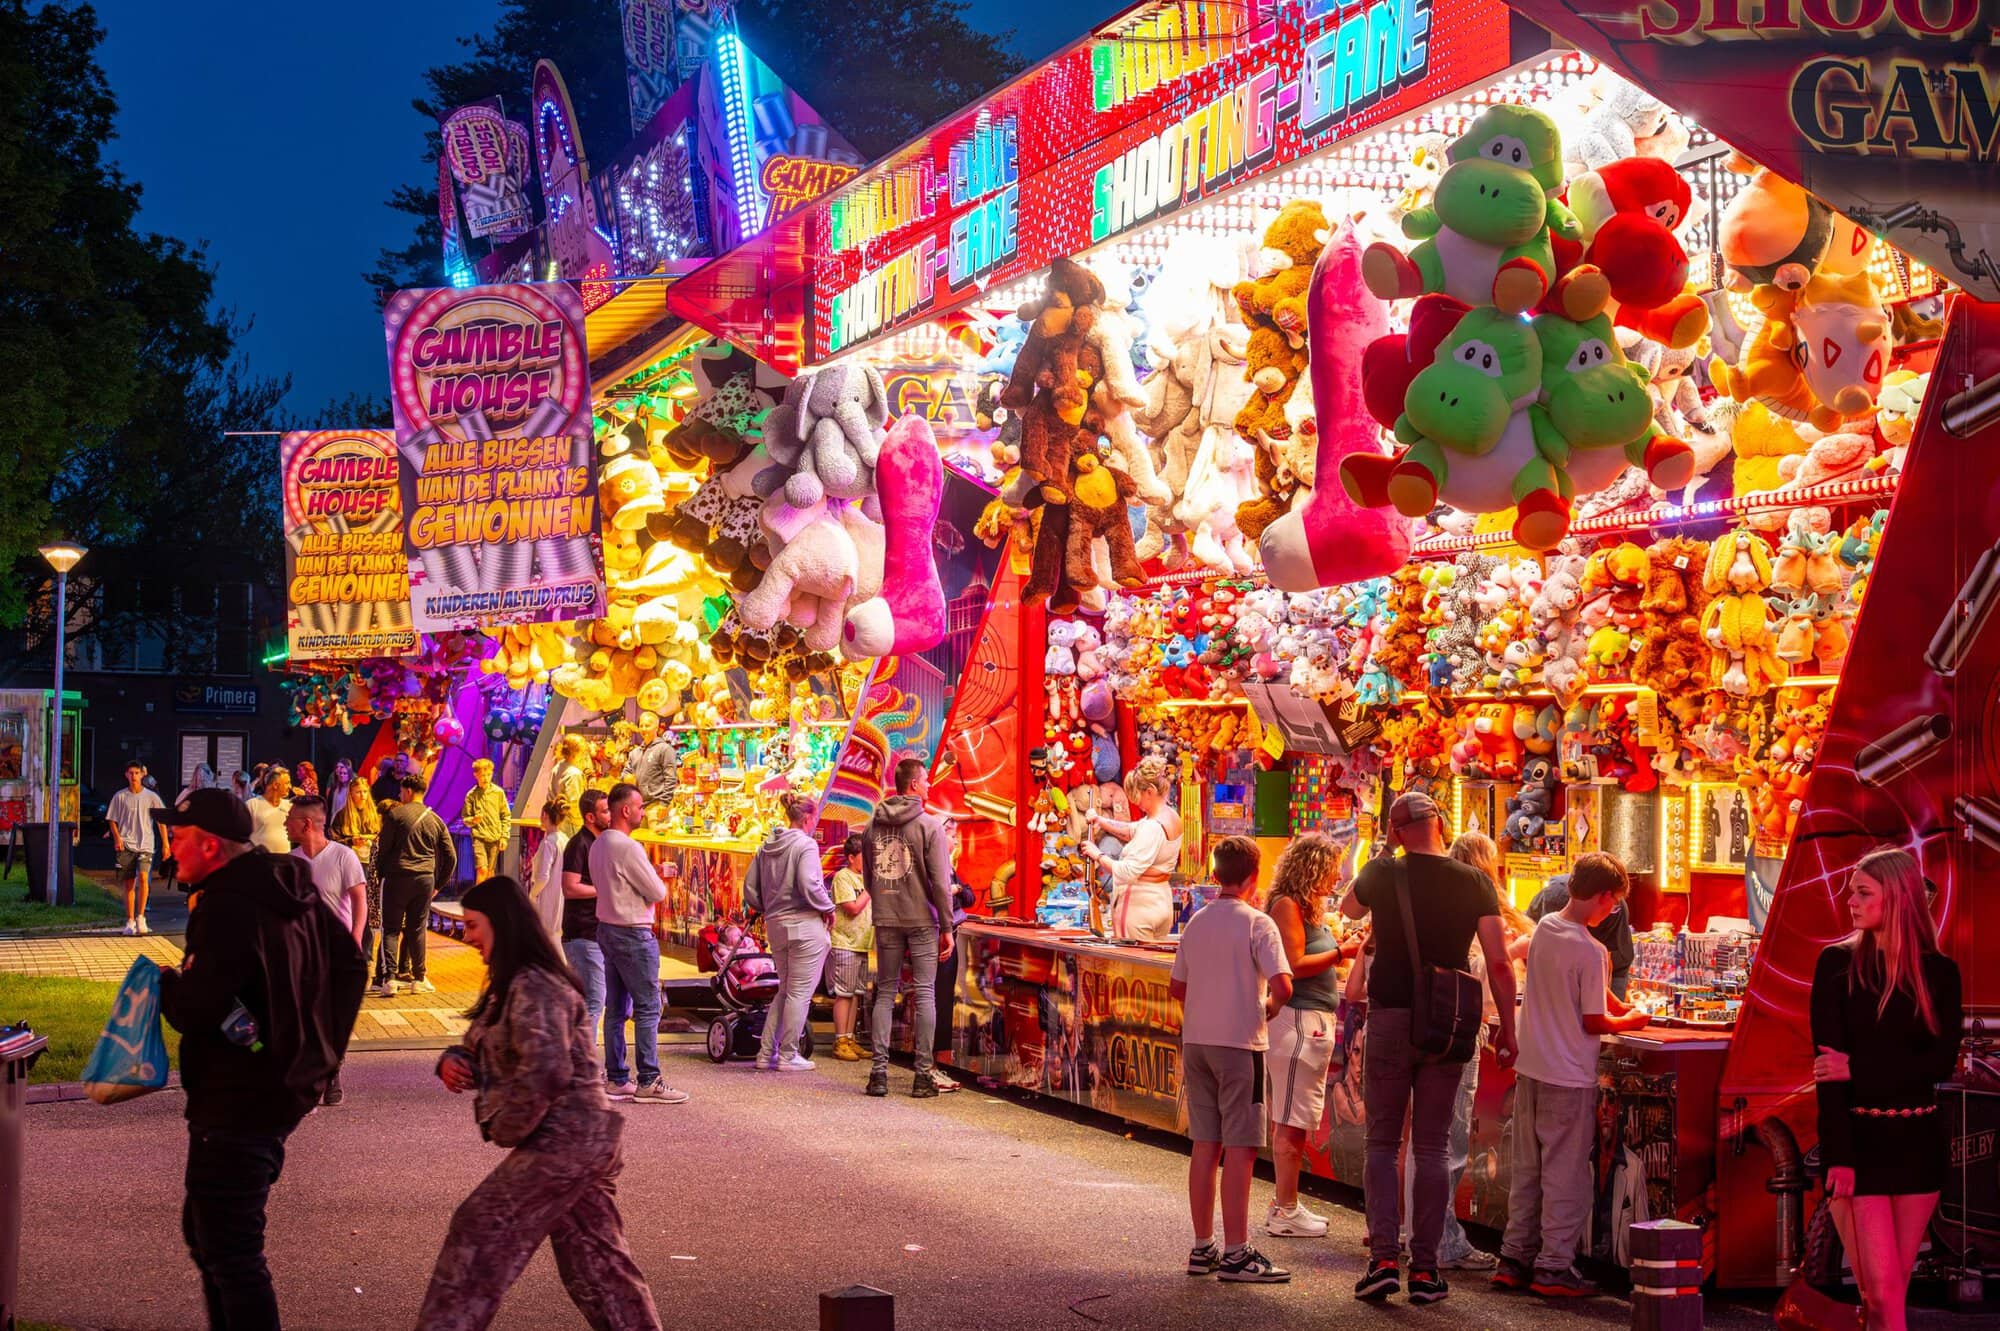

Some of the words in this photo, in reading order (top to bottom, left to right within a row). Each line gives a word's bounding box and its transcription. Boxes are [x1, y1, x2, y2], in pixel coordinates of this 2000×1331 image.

[454, 122, 483, 179] GAMBLE
[473, 122, 501, 170] HOUSE
[412, 320, 562, 368] GAMBLE
[429, 370, 551, 417] HOUSE
[299, 455, 399, 485] GAMBLE
[422, 440, 478, 474] ALLE
[480, 436, 572, 470] BUSSEN
[307, 488, 390, 517] HOUSE
[416, 475, 461, 505] VAN
[463, 473, 491, 502] DE
[495, 468, 562, 499] PLANK
[563, 465, 588, 495] IS
[409, 496, 594, 549] GEWONNEN
[301, 533, 339, 555] ALLE
[341, 531, 404, 553] BUSSEN
[296, 555, 326, 575] VAN
[327, 555, 347, 574] DE
[349, 553, 395, 573] PLANK
[426, 590, 500, 615] KINDEREN
[502, 585, 550, 609] ALTIJD
[549, 582, 595, 607] PRIJS
[298, 634, 348, 649] KINDEREN
[349, 632, 385, 648] ALTIJD
[385, 631, 414, 648] PRIJS
[205, 686, 256, 704] Primera
[1110, 1034, 1178, 1097] GAME
[1951, 1132, 1996, 1162] SHELBY
